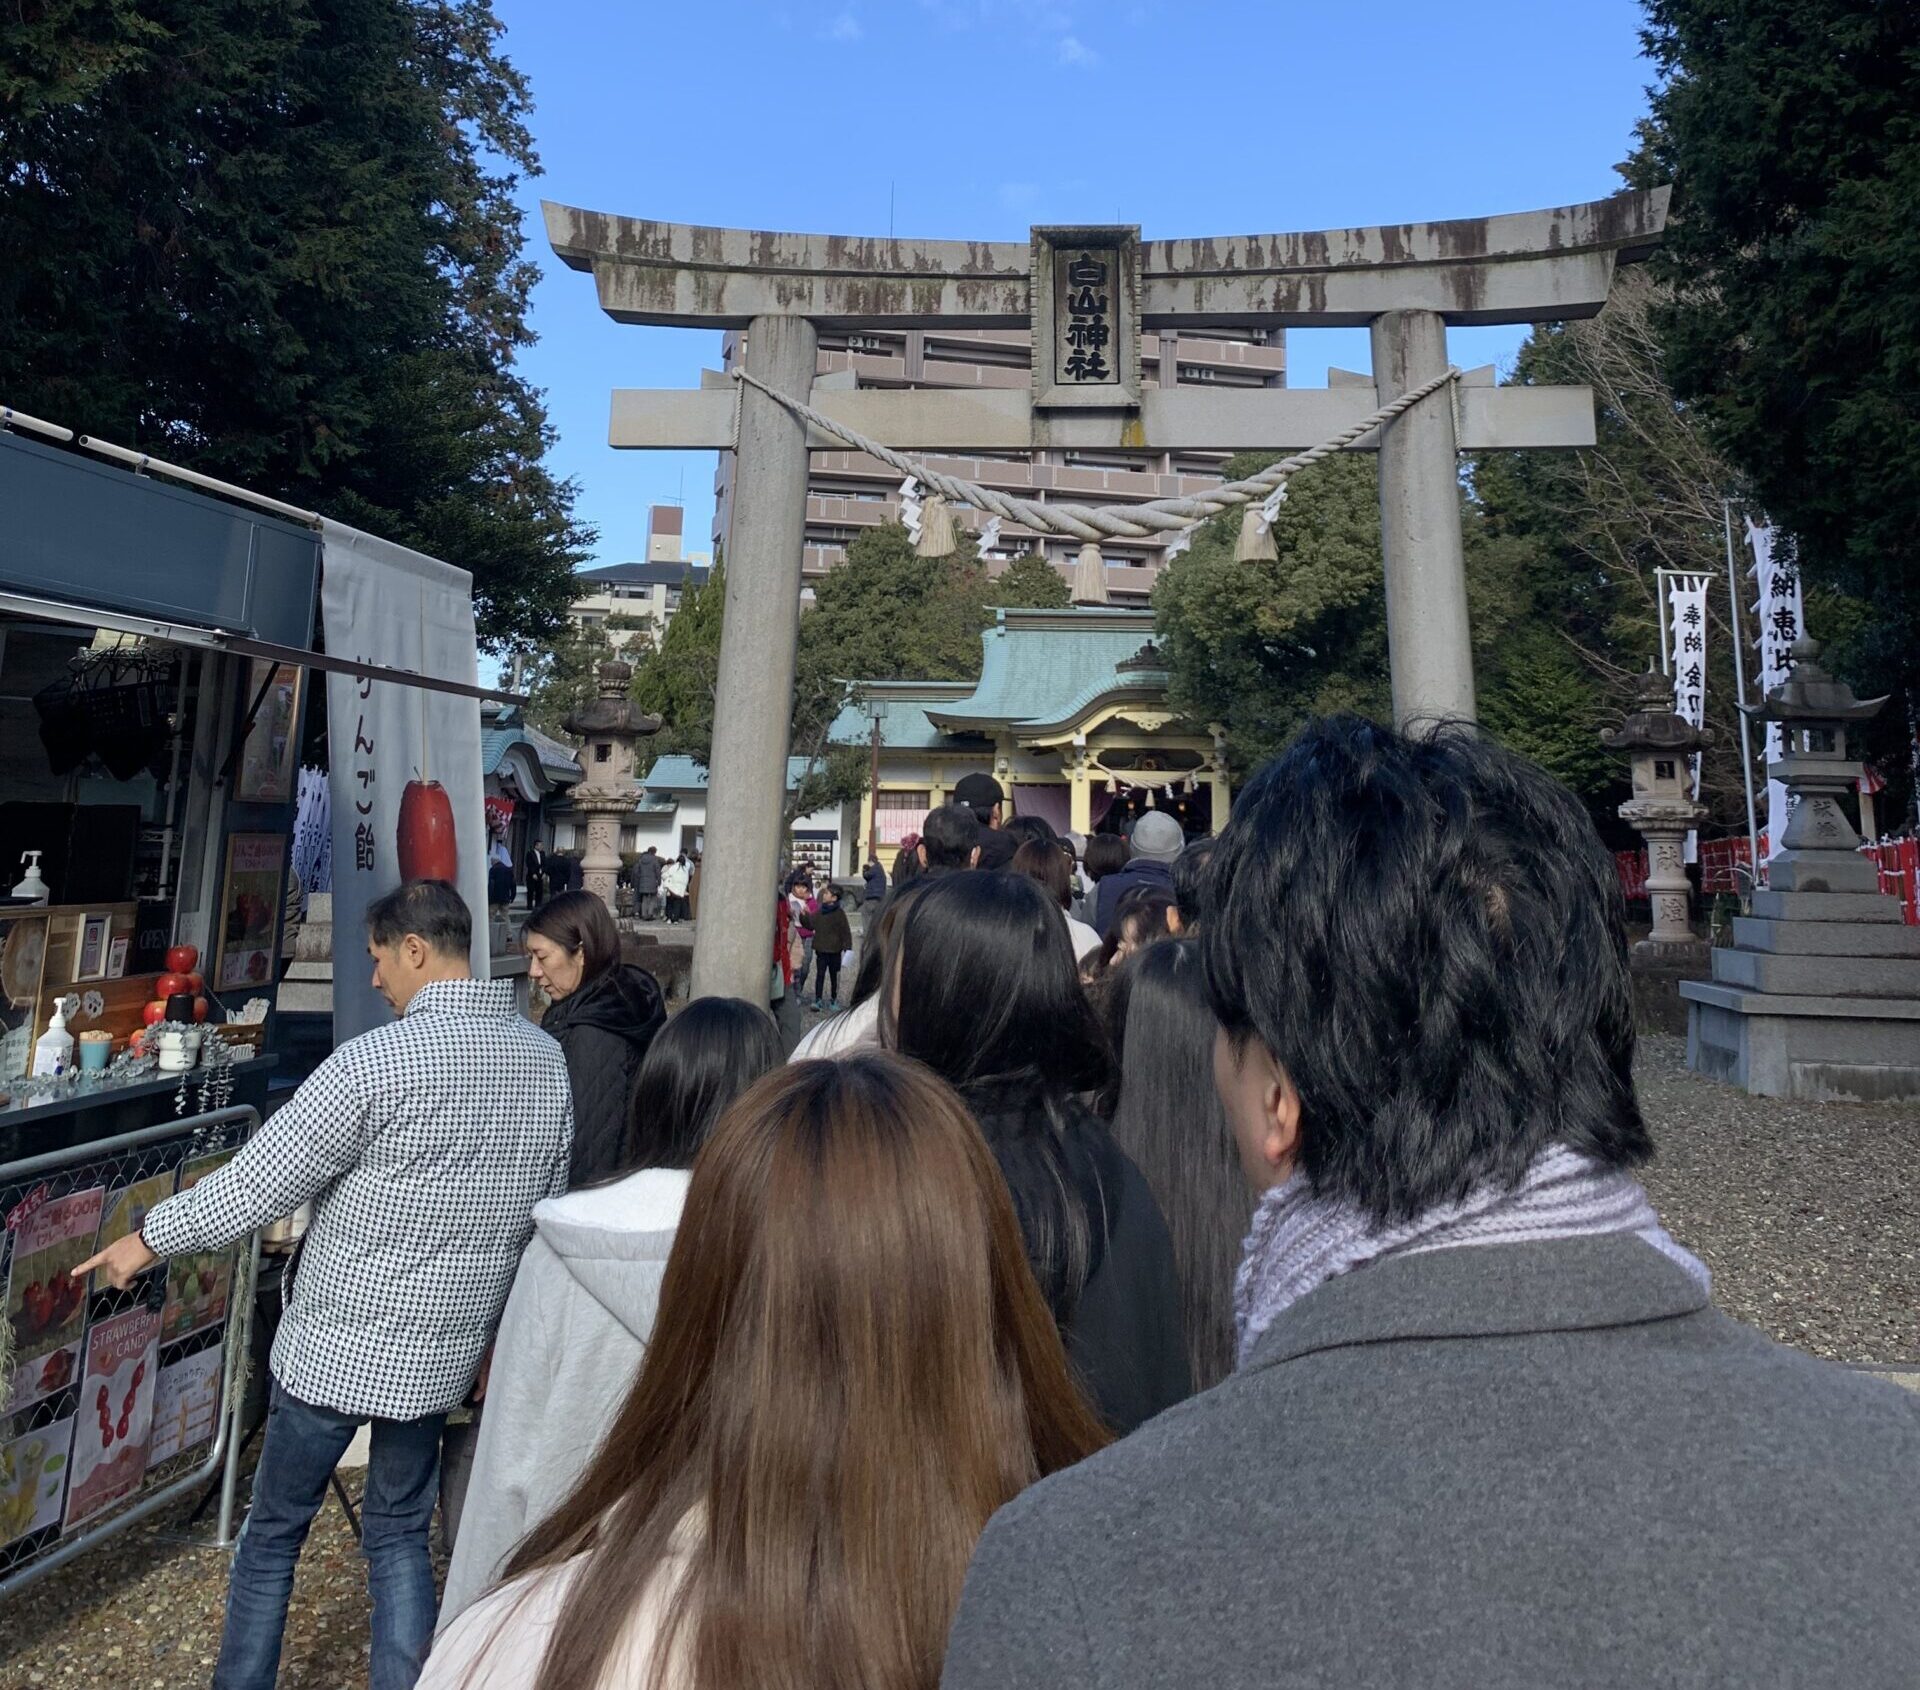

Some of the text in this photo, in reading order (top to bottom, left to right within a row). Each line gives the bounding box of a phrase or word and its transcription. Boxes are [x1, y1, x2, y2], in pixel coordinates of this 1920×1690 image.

[1064, 251, 1110, 382] 白山神社
[355, 655, 375, 872] りんご飴
[116, 1332, 148, 1357] CANDY
